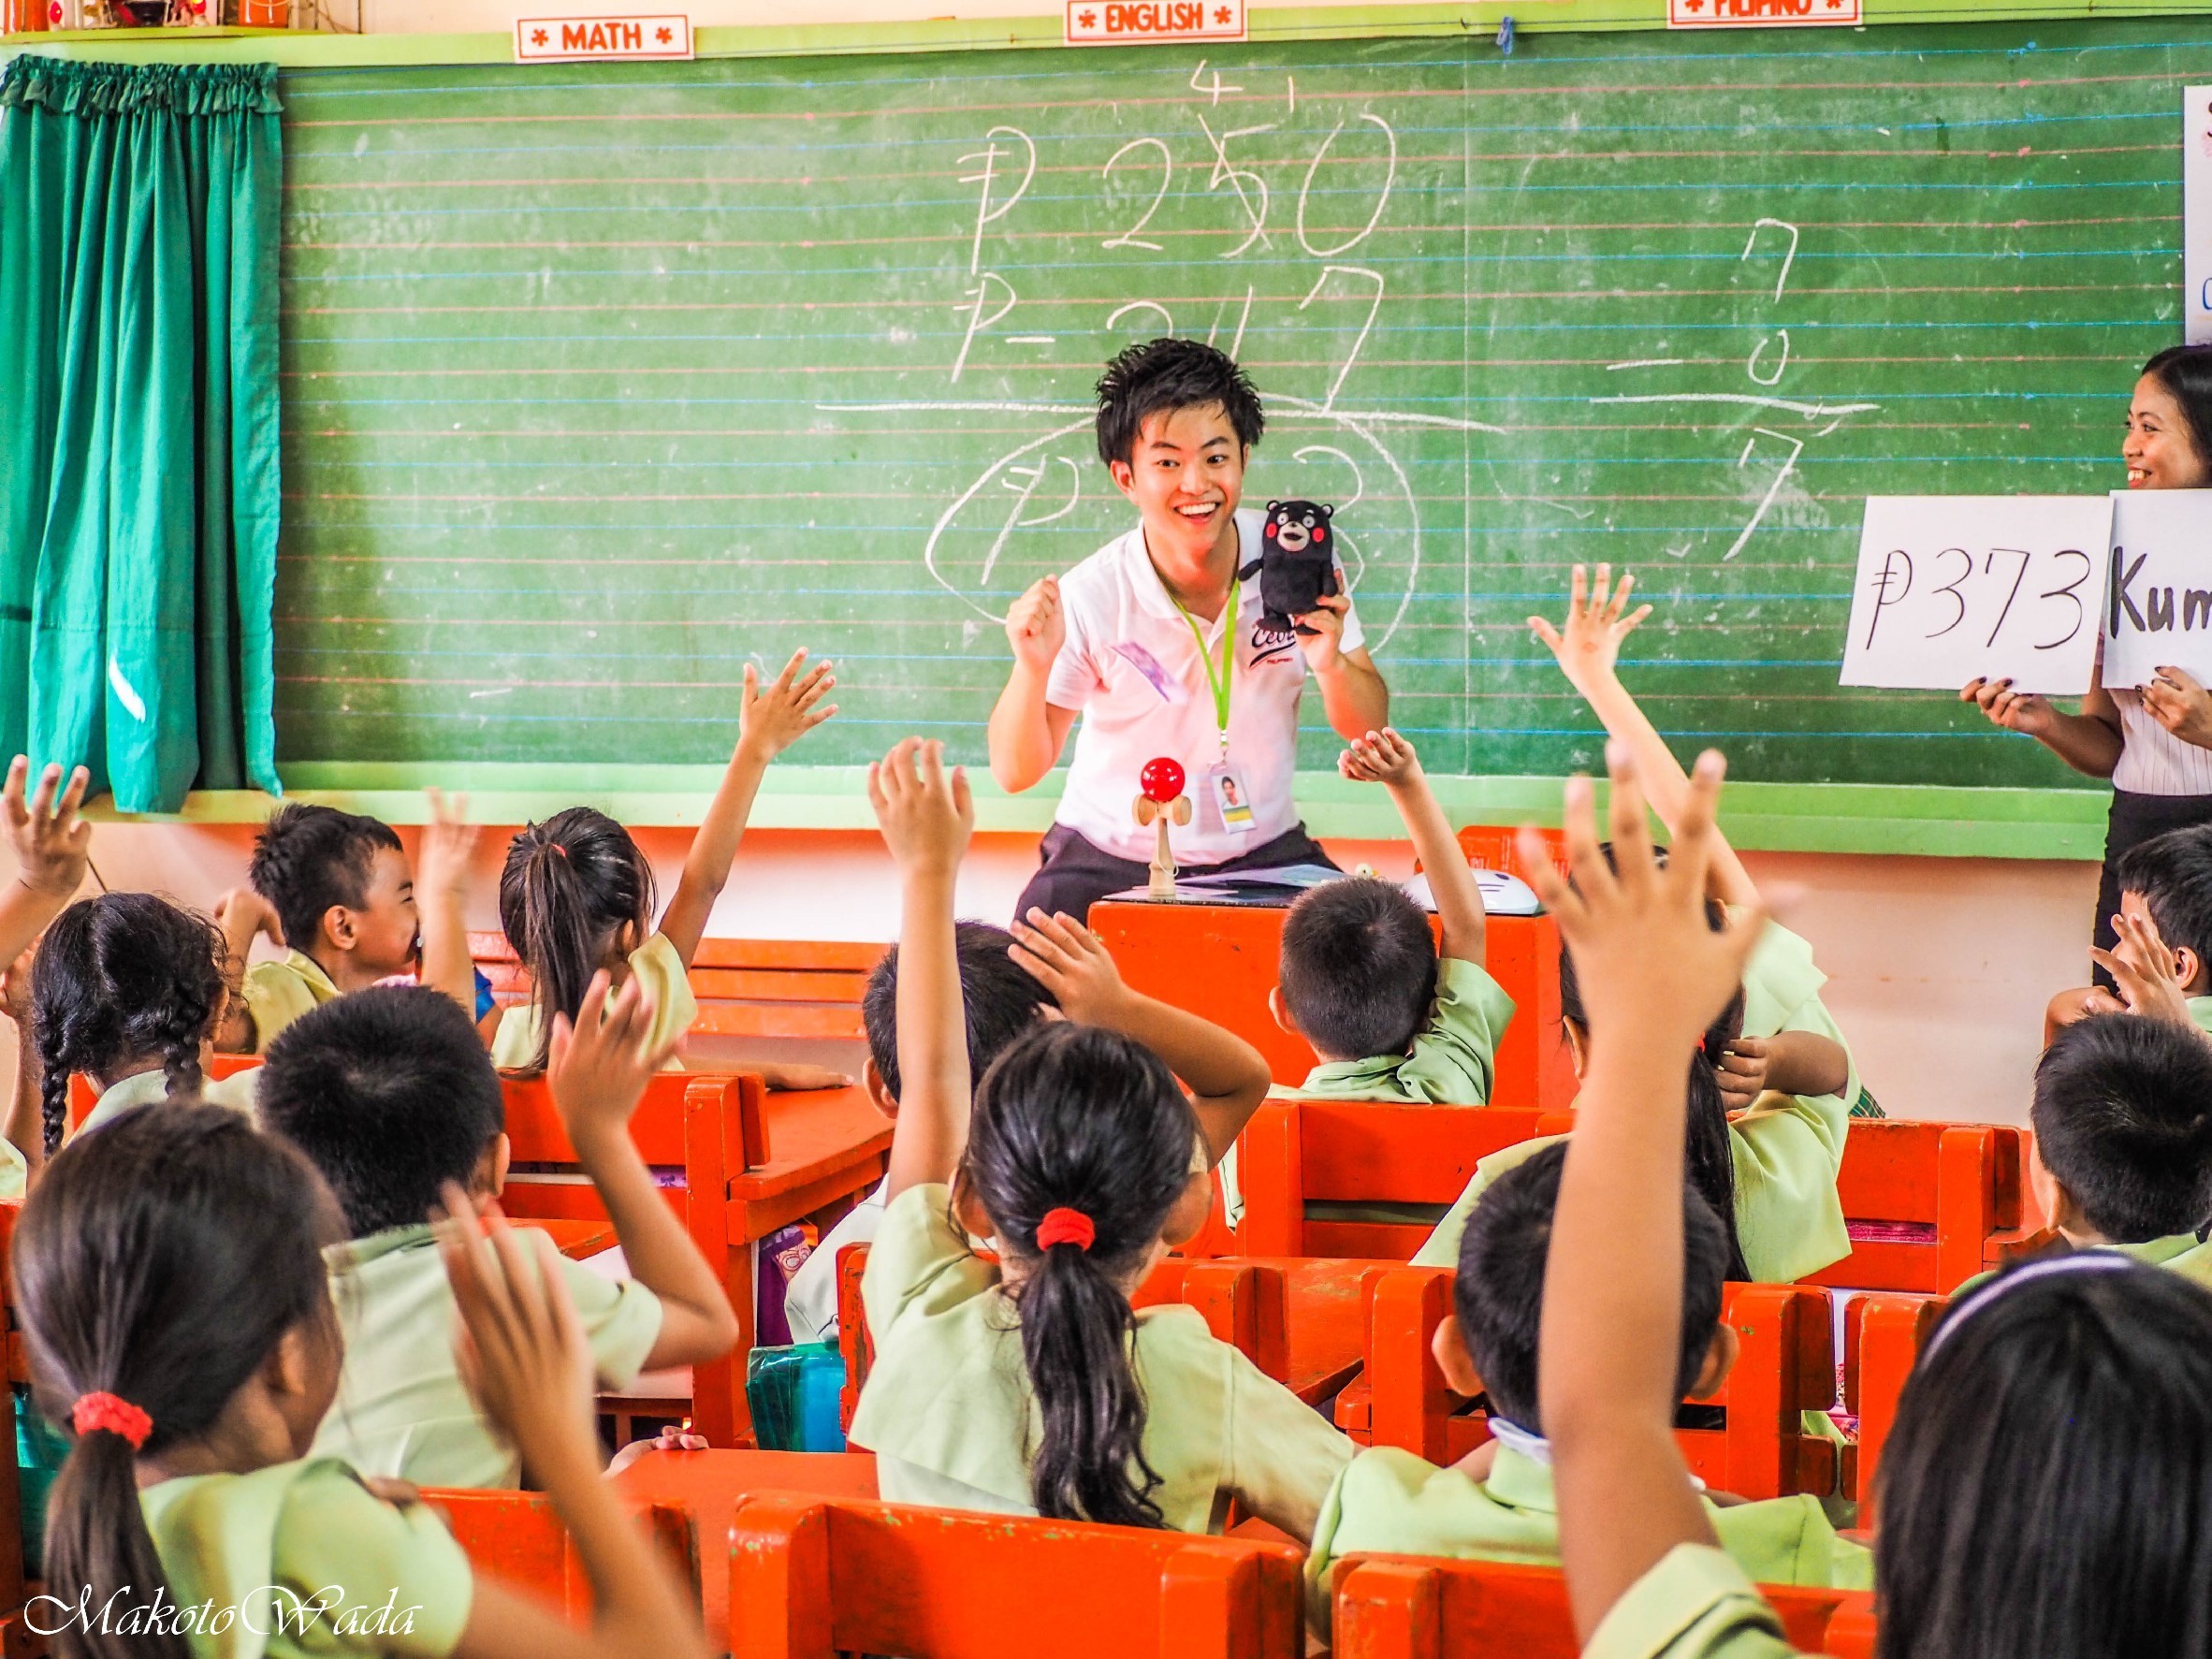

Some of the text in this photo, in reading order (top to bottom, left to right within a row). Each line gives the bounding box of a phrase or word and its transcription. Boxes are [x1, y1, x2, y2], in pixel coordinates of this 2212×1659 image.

[561, 22, 642, 51] MATH
[1105, 2, 1203, 33] ENGLISH
[1191, 59, 1244, 106] 4
[1747, 328, 1789, 386] 0
[1723, 427, 1804, 561] 7
